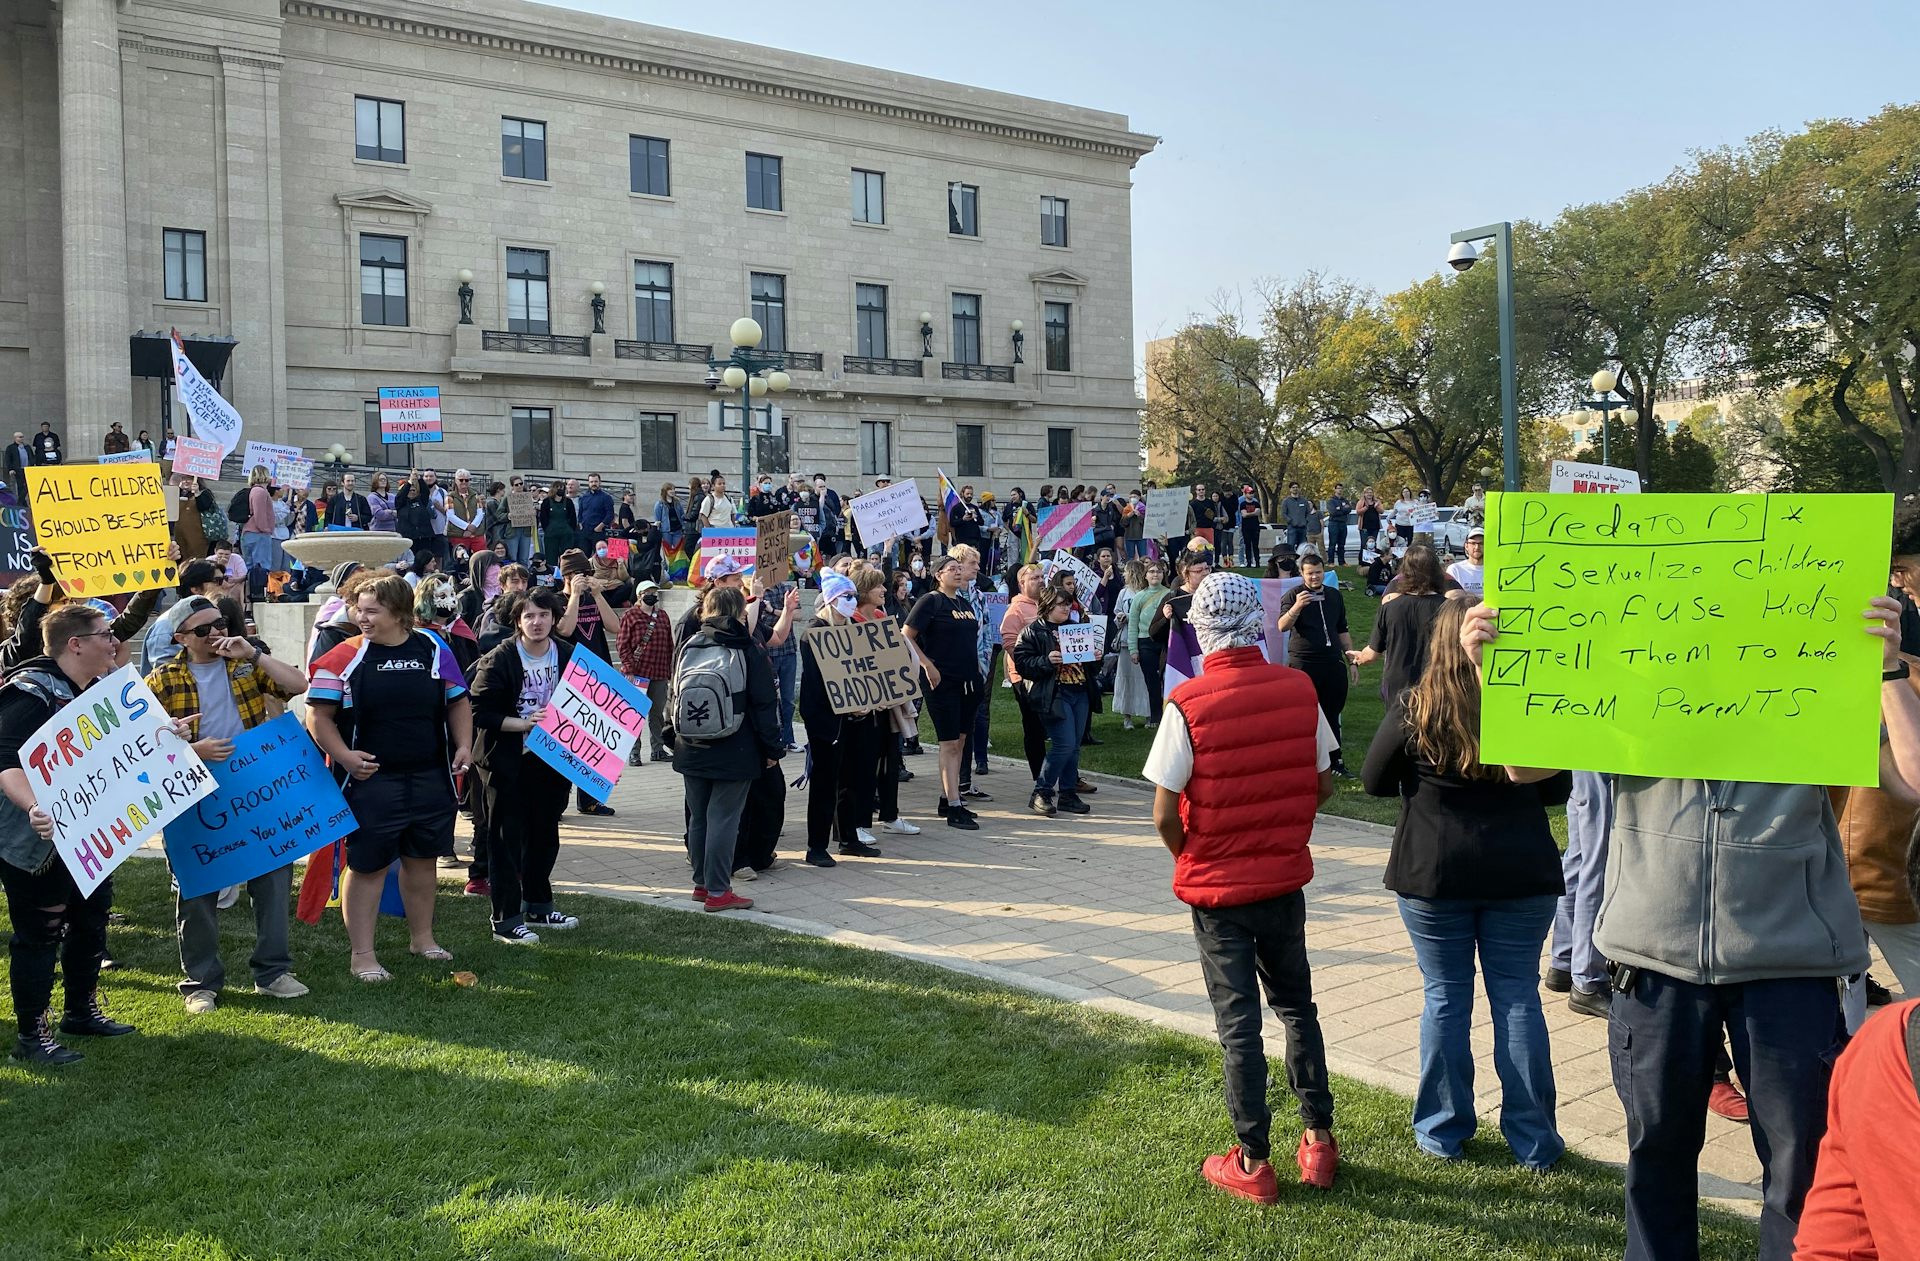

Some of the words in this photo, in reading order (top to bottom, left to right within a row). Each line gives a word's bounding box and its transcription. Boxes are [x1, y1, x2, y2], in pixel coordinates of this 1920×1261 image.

[387, 389, 425, 398] TRANS
[389, 399, 430, 409] RIGHTS
[399, 410, 422, 420] ARE
[391, 423, 427, 432] HUMAN
[391, 432, 432, 442] RIGHTS
[251, 443, 298, 456] information
[1556, 464, 1569, 478] Be
[1573, 470, 1600, 480] careful
[36, 477, 83, 504] ALL
[89, 475, 165, 498] CHILDREN
[40, 517, 101, 538] SHOULD
[102, 513, 130, 530] BE
[129, 508, 168, 530] SAFE
[872, 527, 879, 536] A
[881, 515, 908, 530] THING
[13, 531, 32, 552] IS
[711, 537, 756, 547] PROTECT
[764, 532, 786, 551] EXIST
[50, 549, 116, 576] FROM
[121, 542, 168, 565] HATE
[758, 553, 776, 570] DEAL
[1058, 550, 1075, 569] WE
[1078, 566, 1097, 588] ARE
[769, 567, 778, 585] IT
[809, 619, 900, 660] YOU'RE
[1061, 627, 1091, 637] PROTECT
[1065, 644, 1089, 653] KIDS
[381, 659, 420, 669] Aero
[841, 655, 878, 675] THE
[567, 656, 646, 732] PROTECT
[826, 665, 917, 709] BADDIES
[561, 687, 622, 751] TRANS
[29, 680, 149, 786] TRANS
[550, 709, 606, 768] YOUTH
[229, 752, 259, 774] CALL
[559, 750, 581, 769] SPACE
[577, 761, 592, 778] FOR
[51, 768, 107, 840] Rights
[111, 734, 154, 779] ARE
[250, 824, 276, 842] YOU
[277, 803, 316, 832] WON'T
[74, 790, 163, 881] HUMAN
[269, 839, 298, 858] LIKE
[304, 822, 321, 840] MY
